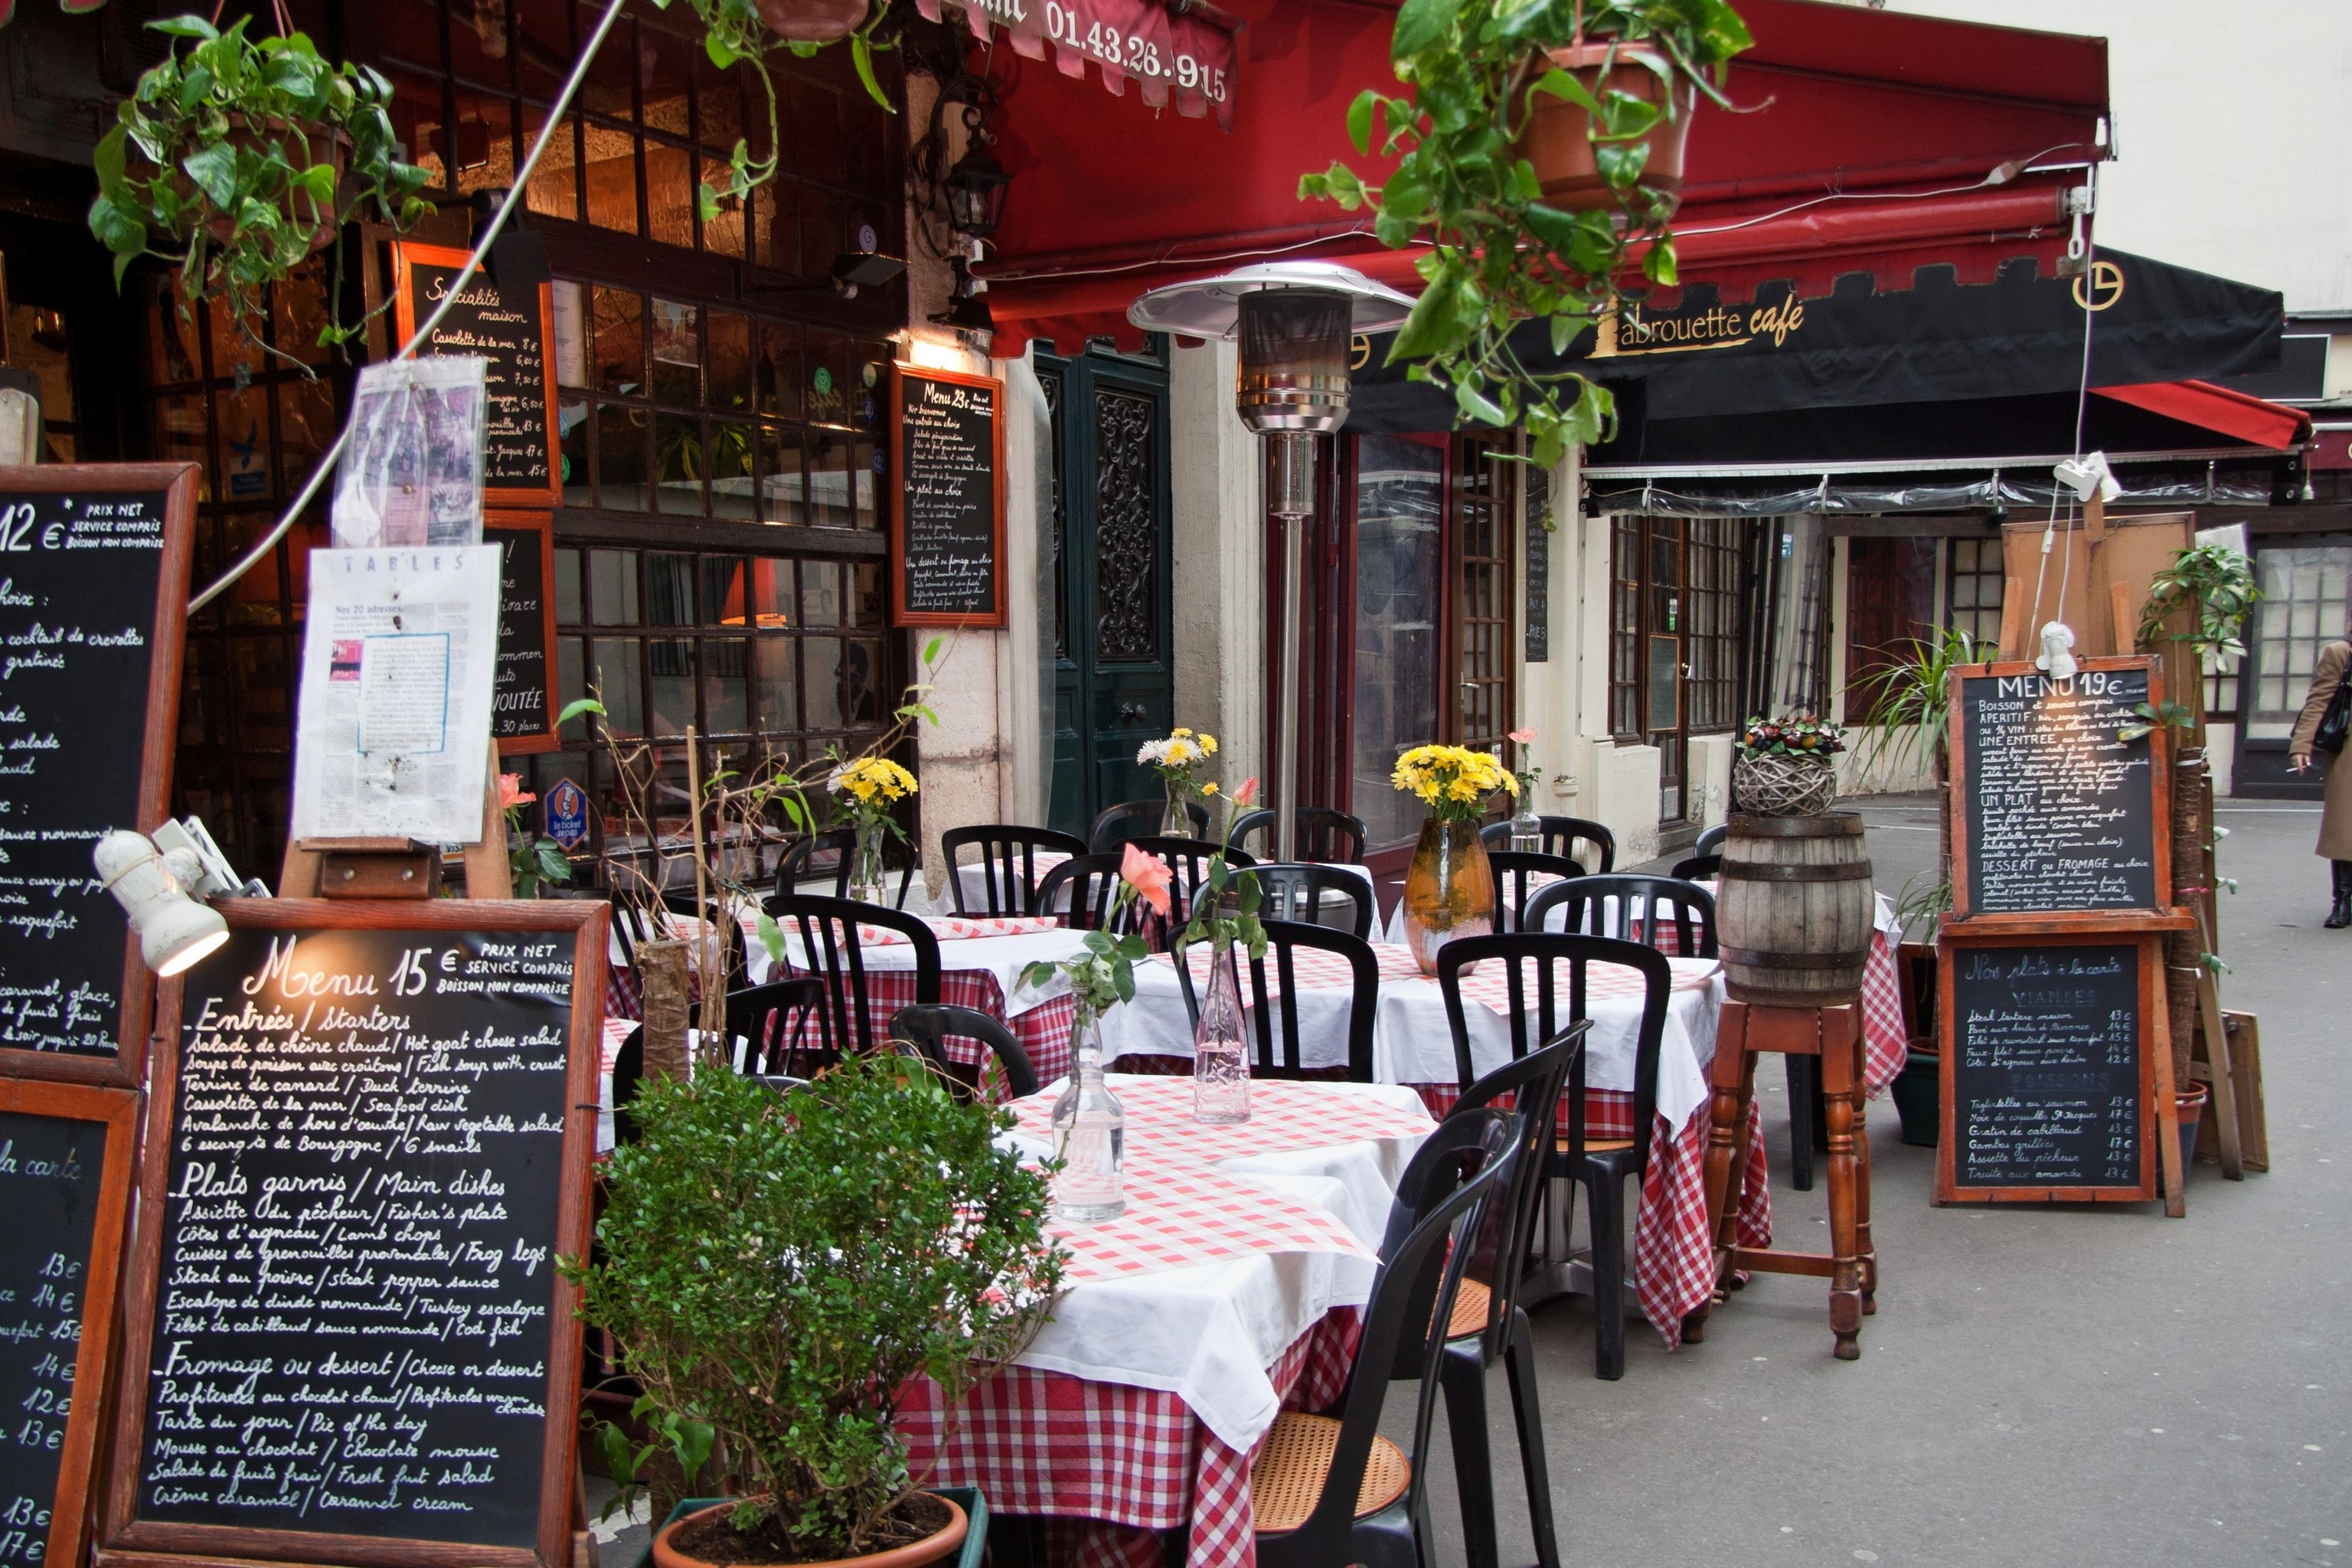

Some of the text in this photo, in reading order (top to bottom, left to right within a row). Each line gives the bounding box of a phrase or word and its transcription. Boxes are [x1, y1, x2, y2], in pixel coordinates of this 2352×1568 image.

[426, 276, 499, 308] Spcialités
[479, 310, 527, 323] maison
[1750, 292, 1803, 347] café
[433, 328, 529, 349] Cassolette 8
[924, 383, 951, 404] Menu
[952, 390, 965, 408] 23
[909, 404, 918, 413] Kir
[903, 415, 960, 429] Une choix
[526, 445, 535, 456] 17
[916, 482, 962, 501] plat choix
[87, 504, 143, 518] PRIX NET
[71, 518, 161, 532] SERVICE COMPRIS
[41, 523, 64, 549] €
[65, 534, 165, 550] BOISSON NON COMPRISE
[919, 554, 939, 567] dessert
[368, 604, 401, 614] adresses
[8, 622, 143, 646] cocktail crevettes
[2, 650, 64, 679] gratinée
[1998, 673, 2122, 700] MENU 19 €
[1979, 699, 2113, 711] BOISSON service compris
[502, 720, 515, 732] 30
[9, 733, 60, 750] salade
[1979, 735, 2004, 746] UNE
[2007, 733, 2057, 745] ENTREE
[1981, 792, 2033, 807] UN PLAT
[562, 820, 580, 828] ticket
[1982, 858, 2148, 872] DESSERT FROMAGE choix
[8, 910, 77, 939] roquefort
[481, 943, 557, 958] PRIX NET
[243, 935, 459, 1000] Menu 15 €
[466, 960, 573, 975] SERVICE COMPRIS
[436, 978, 570, 997] BOISSON NON COMPRISE
[16, 1000, 101, 1030] fruits frais
[196, 996, 410, 1031] Entrées Starters
[1968, 1009, 1994, 1022] Steak
[1998, 1011, 2032, 1021] tartare
[2110, 1011, 2121, 1020] 13
[186, 1025, 561, 1063] Salade chèvre goat cheese salad
[184, 1050, 567, 1081] Soupe poisson Fish soup crust
[182, 1074, 399, 1093] Terrine canard Duck
[184, 1093, 468, 1121] Cassolette Seafood dish
[2110, 1096, 2122, 1106] 13
[454, 1115, 514, 1145] vegetable
[2027, 1124, 2082, 1135] cabillaud
[297, 1133, 481, 1162] Bourgogne snails
[1969, 1138, 2121, 1148] Gambas 17
[1968, 1152, 2008, 1163] Assiette
[1968, 1168, 2081, 1178] Truite amandes
[173, 1162, 505, 1220] Plats garnis Main dishes
[178, 1200, 455, 1233] Assiette pêcheur Fisher's
[337, 1221, 443, 1251] Lamb chops
[465, 1238, 546, 1276] Frog legs
[257, 1268, 499, 1295] poivre sauce
[420, 1298, 471, 1328] Turkey
[234, 1316, 522, 1347] cabillaud Cod fish
[161, 1341, 544, 1400] Fromage dessert Cheese dessert
[291, 1384, 349, 1403] chocolat
[157, 1407, 427, 1442] Tarte day
[153, 1431, 420, 1459] Mousse Chocolate
[338, 1464, 495, 1485] Fresh salad
[153, 1486, 473, 1511] Crème Caramel cream
[2, 1497, 34, 1525] 13
